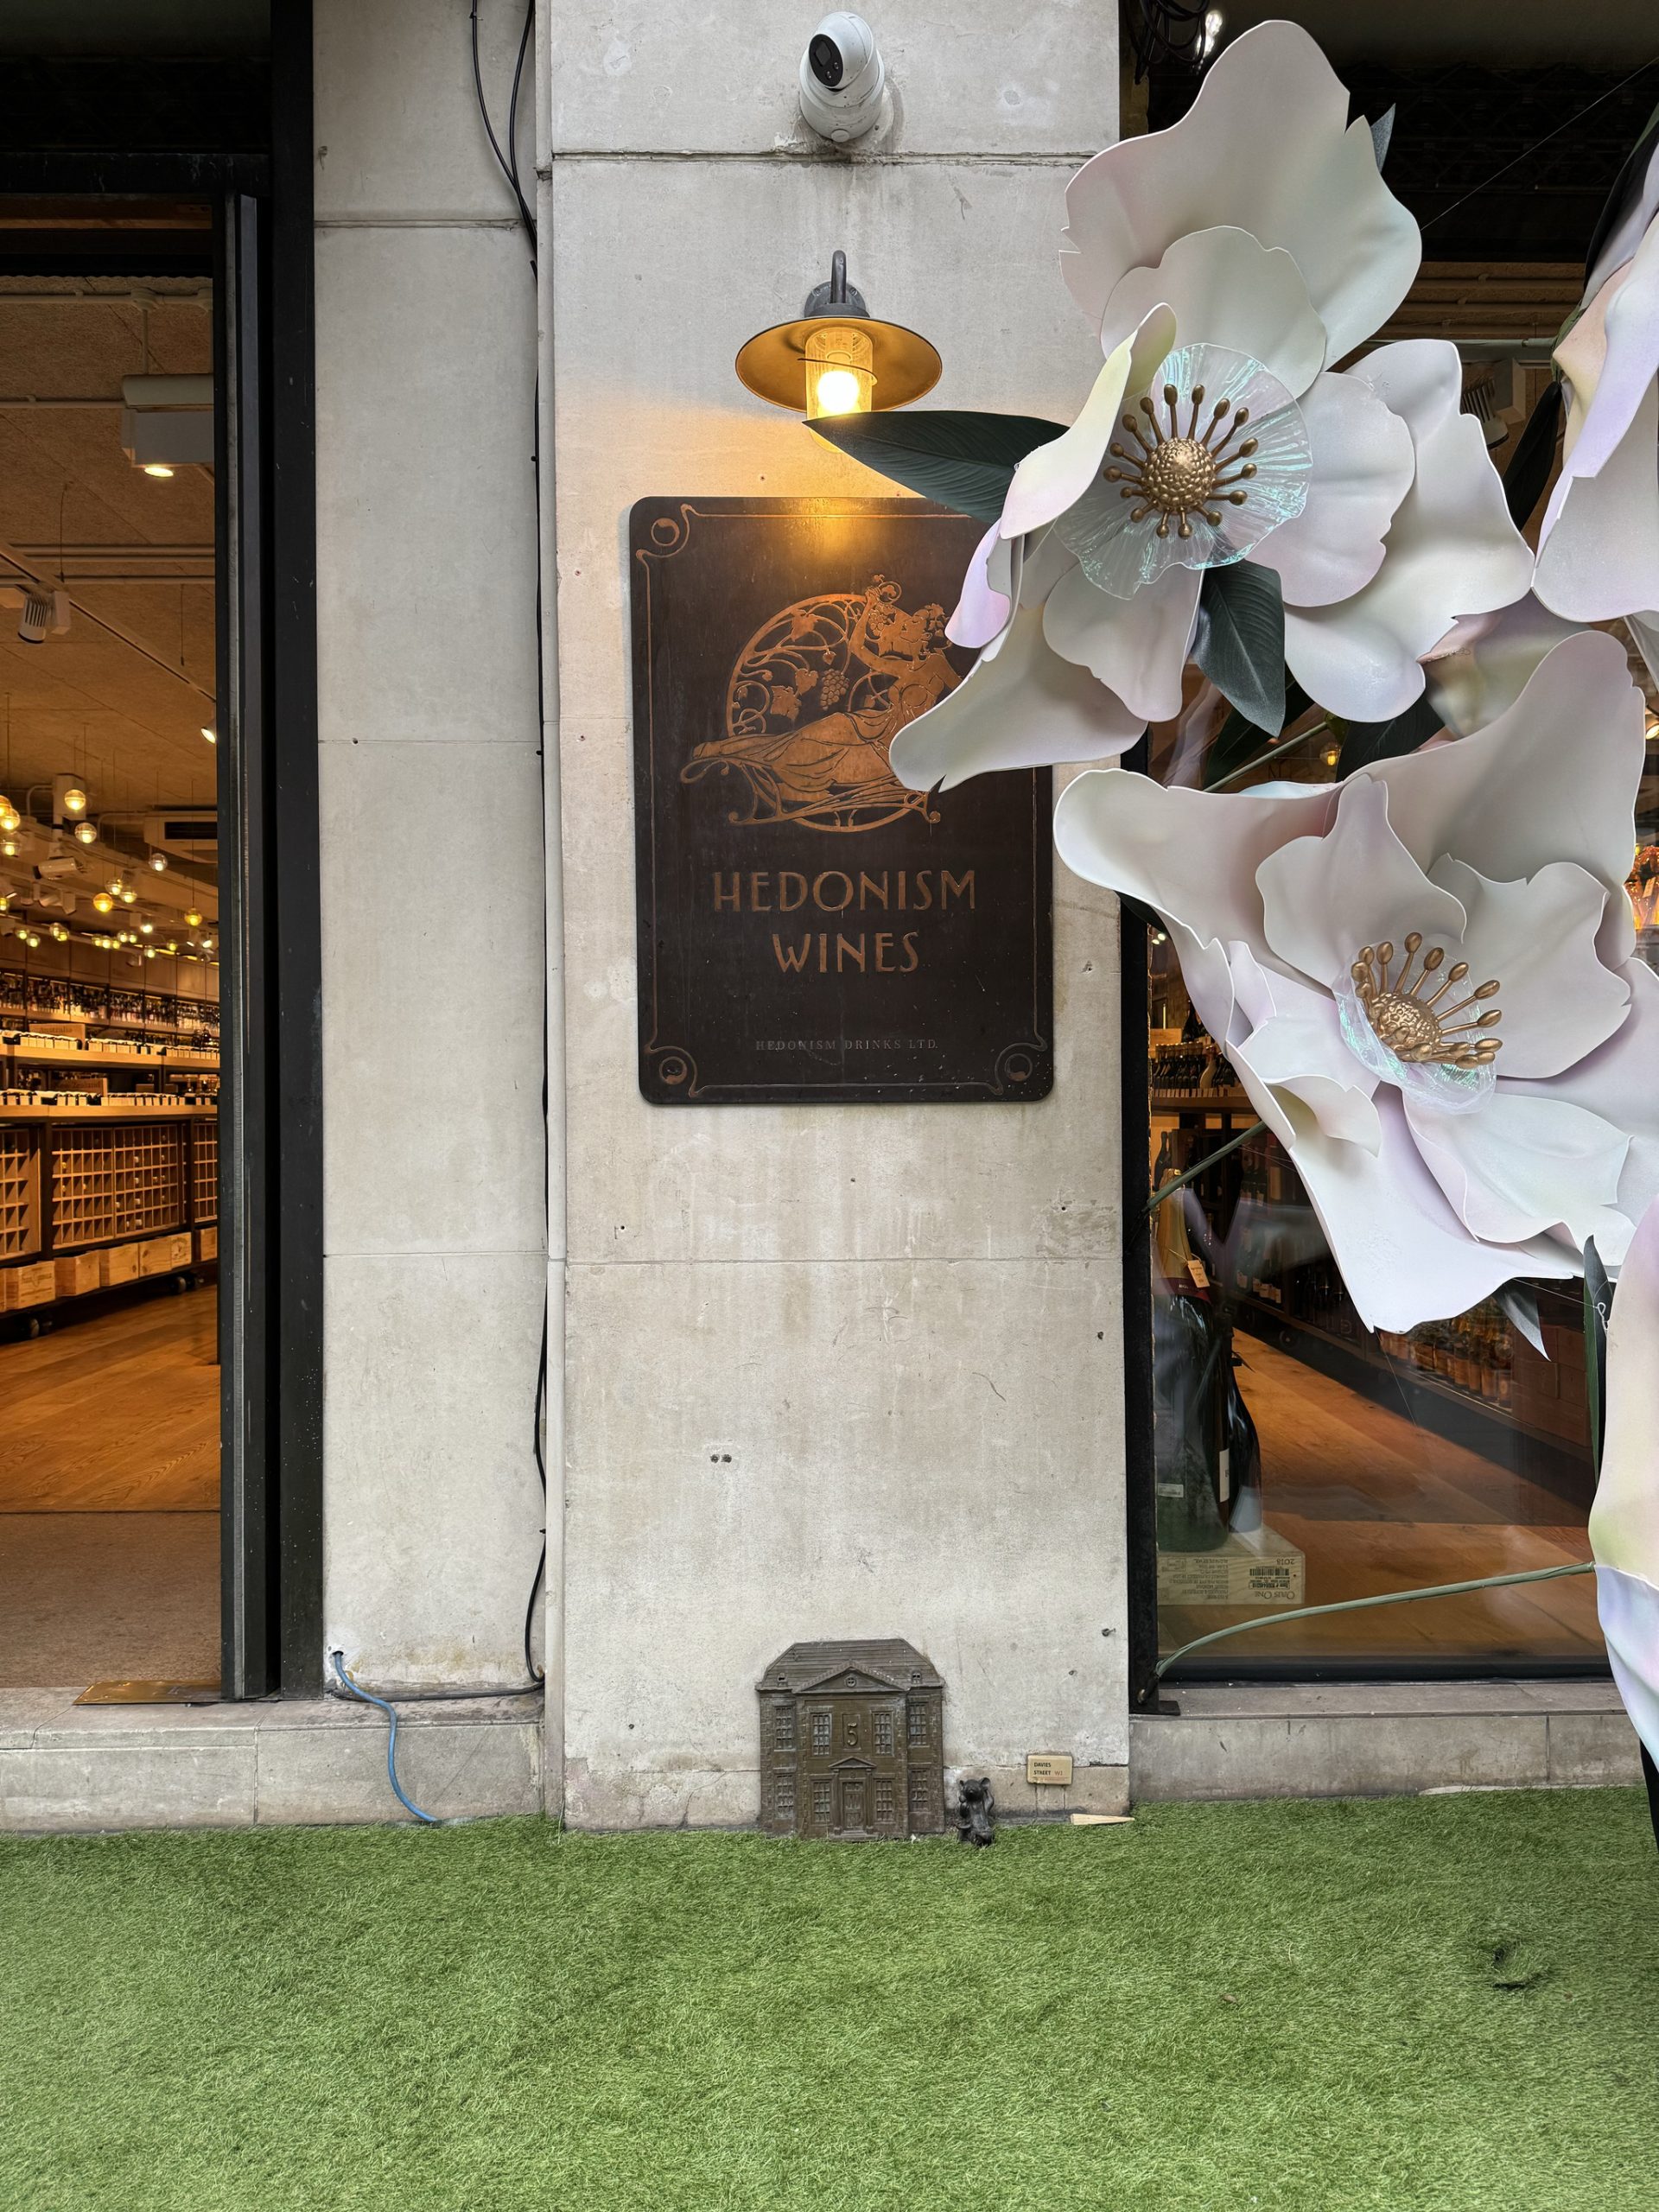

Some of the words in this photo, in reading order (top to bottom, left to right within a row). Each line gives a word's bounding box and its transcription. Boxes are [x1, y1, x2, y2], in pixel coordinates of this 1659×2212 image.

[713, 869, 976, 912] HEDONISM
[772, 931, 920, 974] WINES
[755, 1039, 837, 1051] HEDONISM
[844, 1039, 902, 1050] DRINKS
[908, 1039, 939, 1050] LTD.
[847, 1721, 858, 1746] 5
